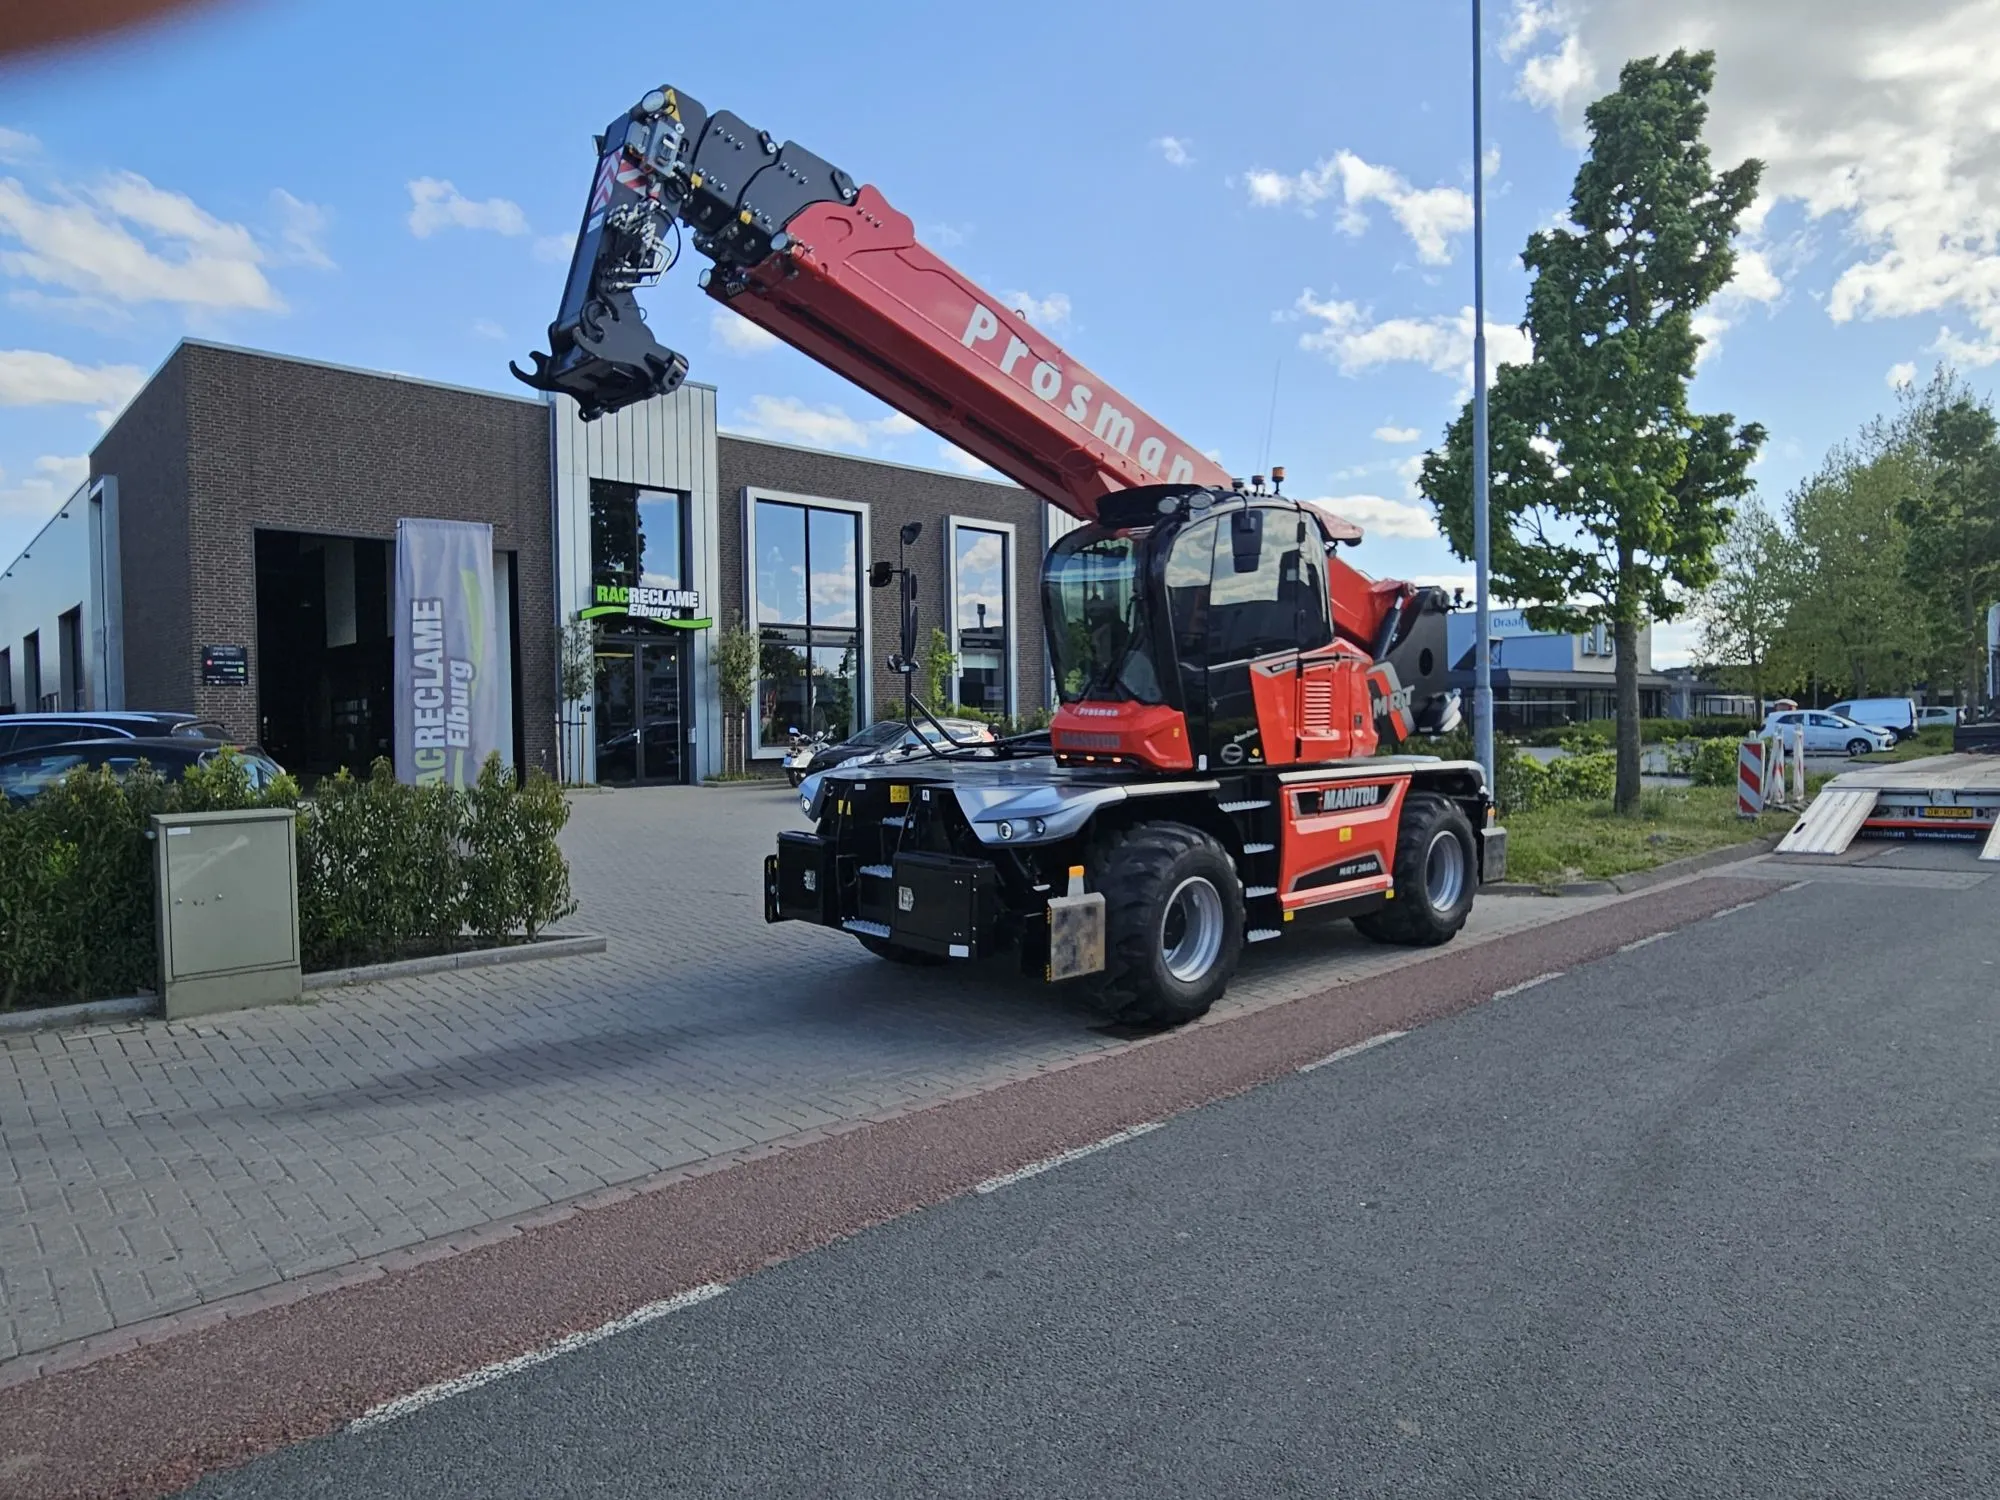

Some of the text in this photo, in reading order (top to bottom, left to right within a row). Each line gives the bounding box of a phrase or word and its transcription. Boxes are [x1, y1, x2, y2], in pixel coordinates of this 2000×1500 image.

[961, 303, 1195, 485] Prosman
[597, 585, 699, 608] RACRECLAME
[628, 604, 672, 620] Elburg
[413, 599, 446, 788] ACRECLAME
[447, 660, 474, 748] Elburg
[1324, 785, 1379, 810] MANITOU
